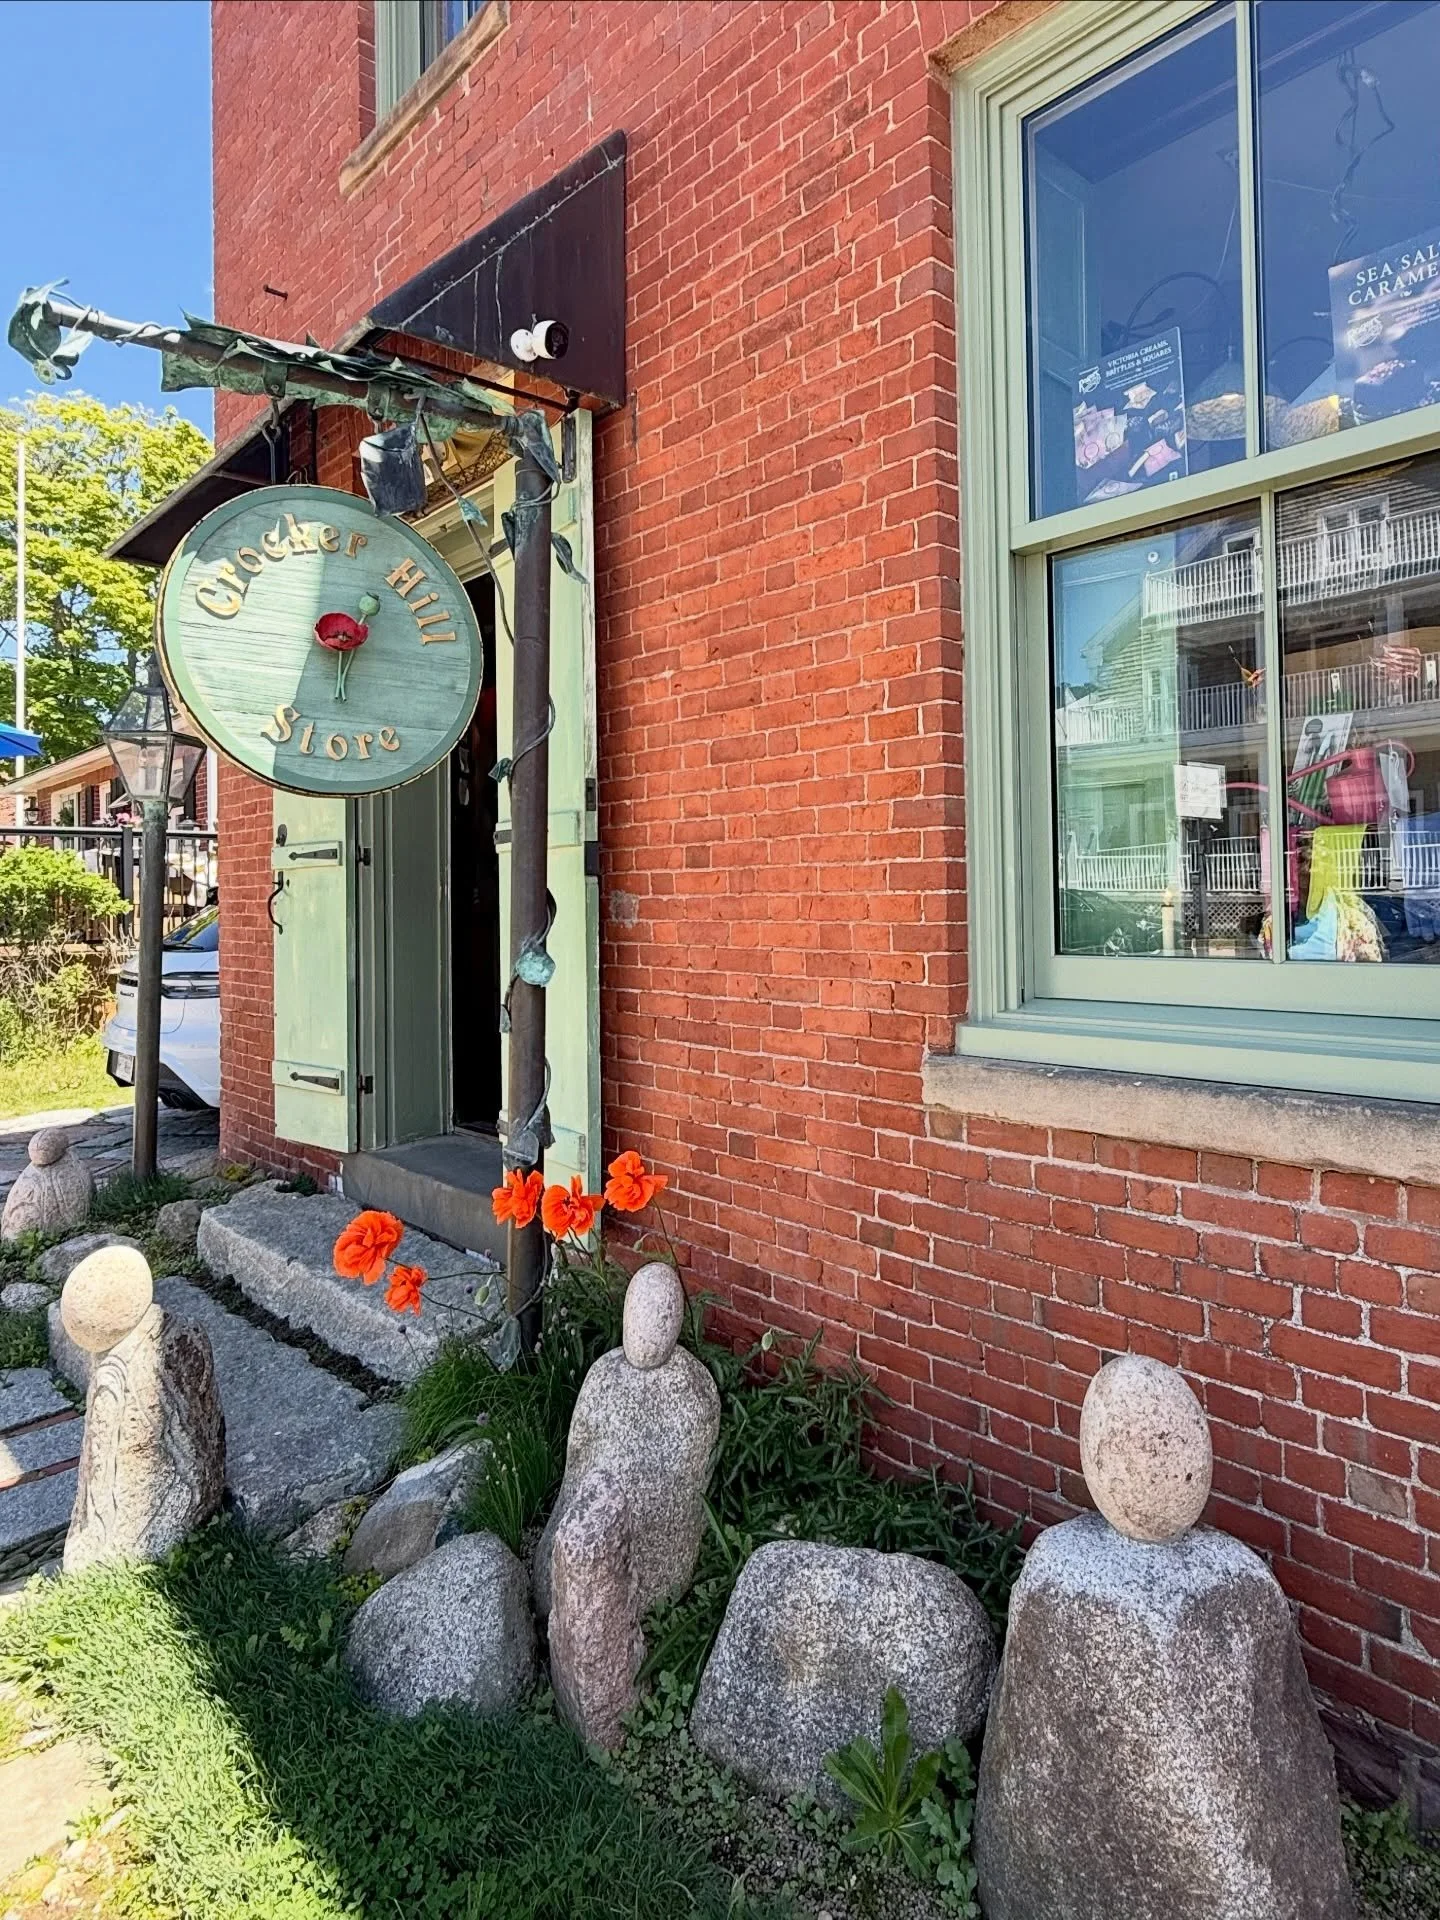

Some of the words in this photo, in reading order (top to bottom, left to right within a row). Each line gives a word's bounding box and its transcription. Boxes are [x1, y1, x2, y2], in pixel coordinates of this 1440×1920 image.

[1348, 261, 1440, 306] CARAME
[1356, 262, 1393, 287] SEA
[1401, 242, 1440, 270] SAL
[1107, 352, 1139, 368] VICTORIA
[1142, 345, 1172, 363] SQUARES
[194, 512, 368, 620] Crocker
[383, 556, 457, 646] Hill
[259, 703, 401, 761] Store
